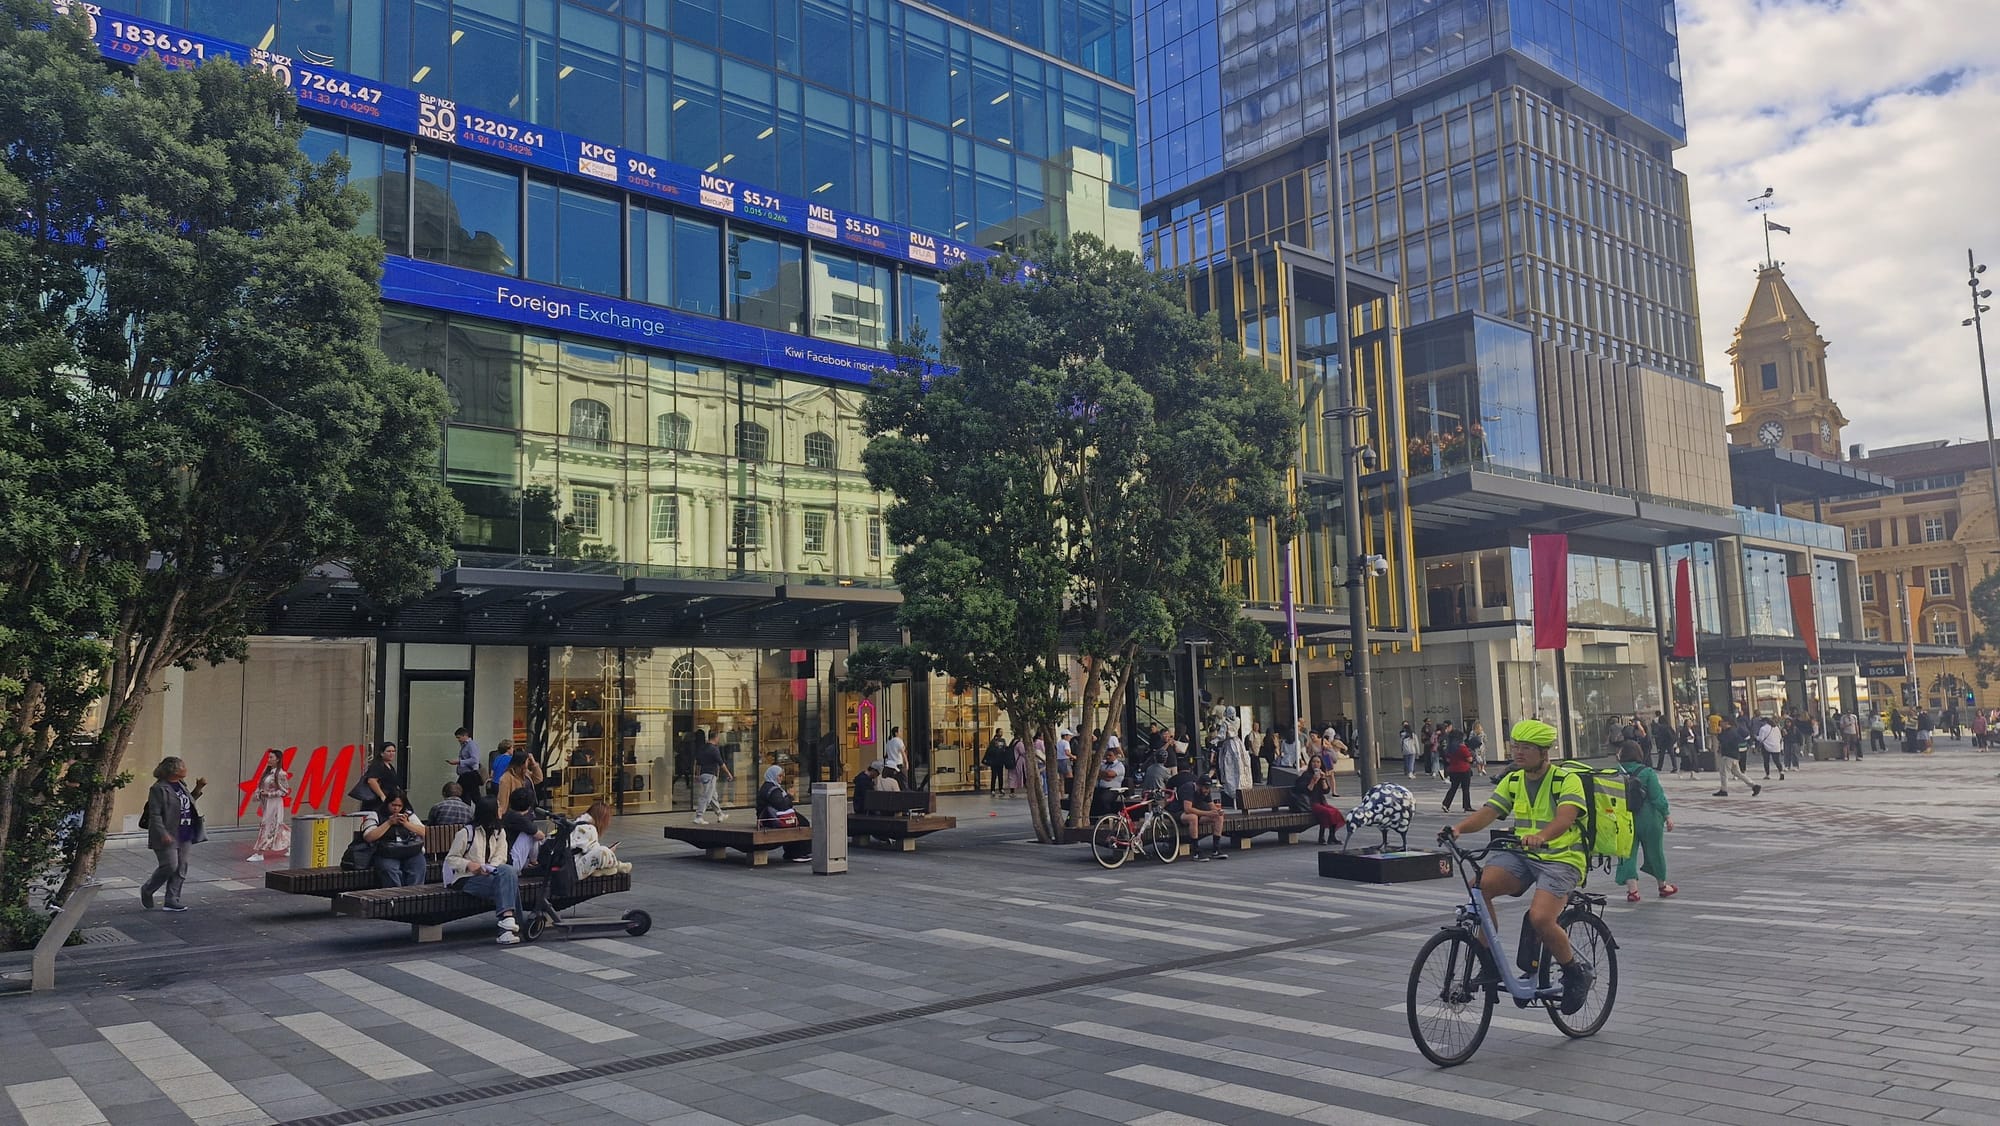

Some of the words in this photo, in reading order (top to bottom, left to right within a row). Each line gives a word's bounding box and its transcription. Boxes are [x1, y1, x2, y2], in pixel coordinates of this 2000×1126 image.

[111, 40, 138, 54] 7.97
[112, 22, 204, 58] 1836.91
[300, 70, 382, 104] 7264.47
[300, 89, 330, 104] 31.33
[340, 99, 380, 117] 0.429%
[419, 93, 455, 110] S&P/NZX
[419, 103, 455, 132] 50
[419, 126, 456, 143] INDEX
[463, 115, 544, 147] 12207.61
[463, 132, 489, 145] 41.94
[499, 140, 533, 156] 0.342%
[581, 142, 616, 163] KPG
[628, 159, 657, 178] 90¢
[700, 174, 735, 194] MCY
[743, 190, 780, 210] $5.71
[809, 204, 836, 222] MEL
[845, 218, 880, 237] $5.50
[910, 232, 935, 248] RUA
[498, 287, 571, 318] Foreign
[578, 302, 665, 336] Exchange
[785, 346, 804, 359] Kiwi
[807, 350, 852, 368] Facebook
[1869, 667, 1895, 675] BOSS
[316, 830, 328, 868] ecycling
